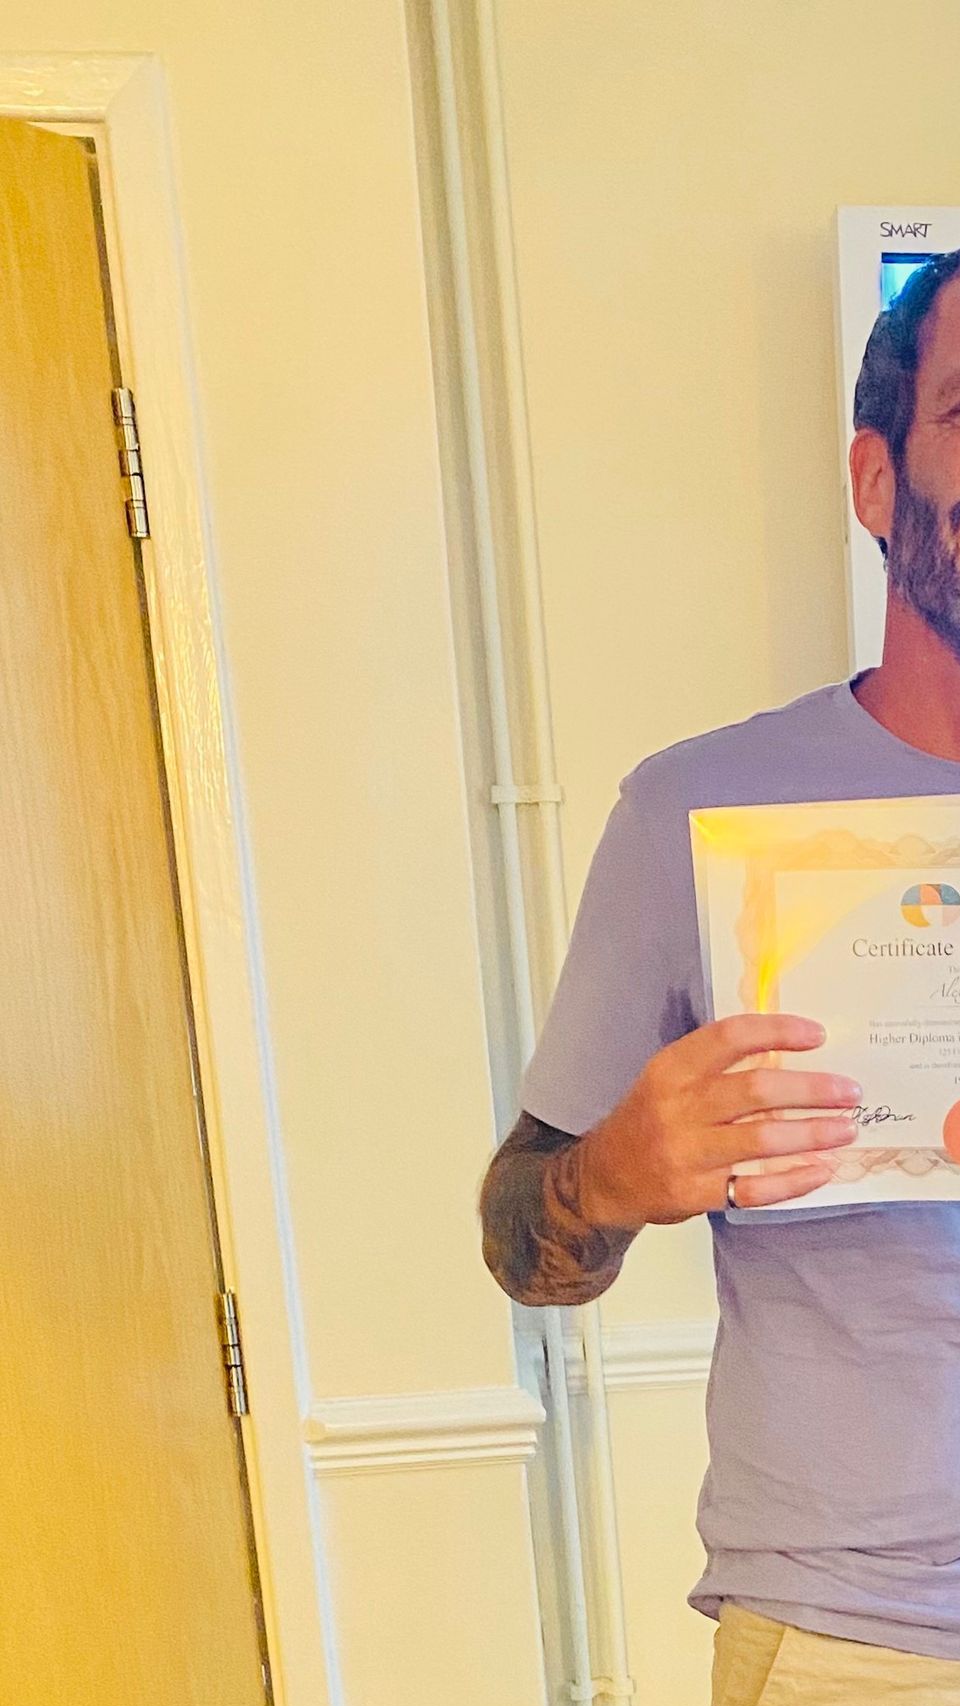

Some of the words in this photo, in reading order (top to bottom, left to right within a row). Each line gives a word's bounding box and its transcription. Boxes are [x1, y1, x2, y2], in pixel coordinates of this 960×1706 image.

[880, 221, 932, 238] SMART
[852, 937, 954, 958] Certificate
[869, 1033, 905, 1046] Higher
[909, 1032, 955, 1047] Diploma
